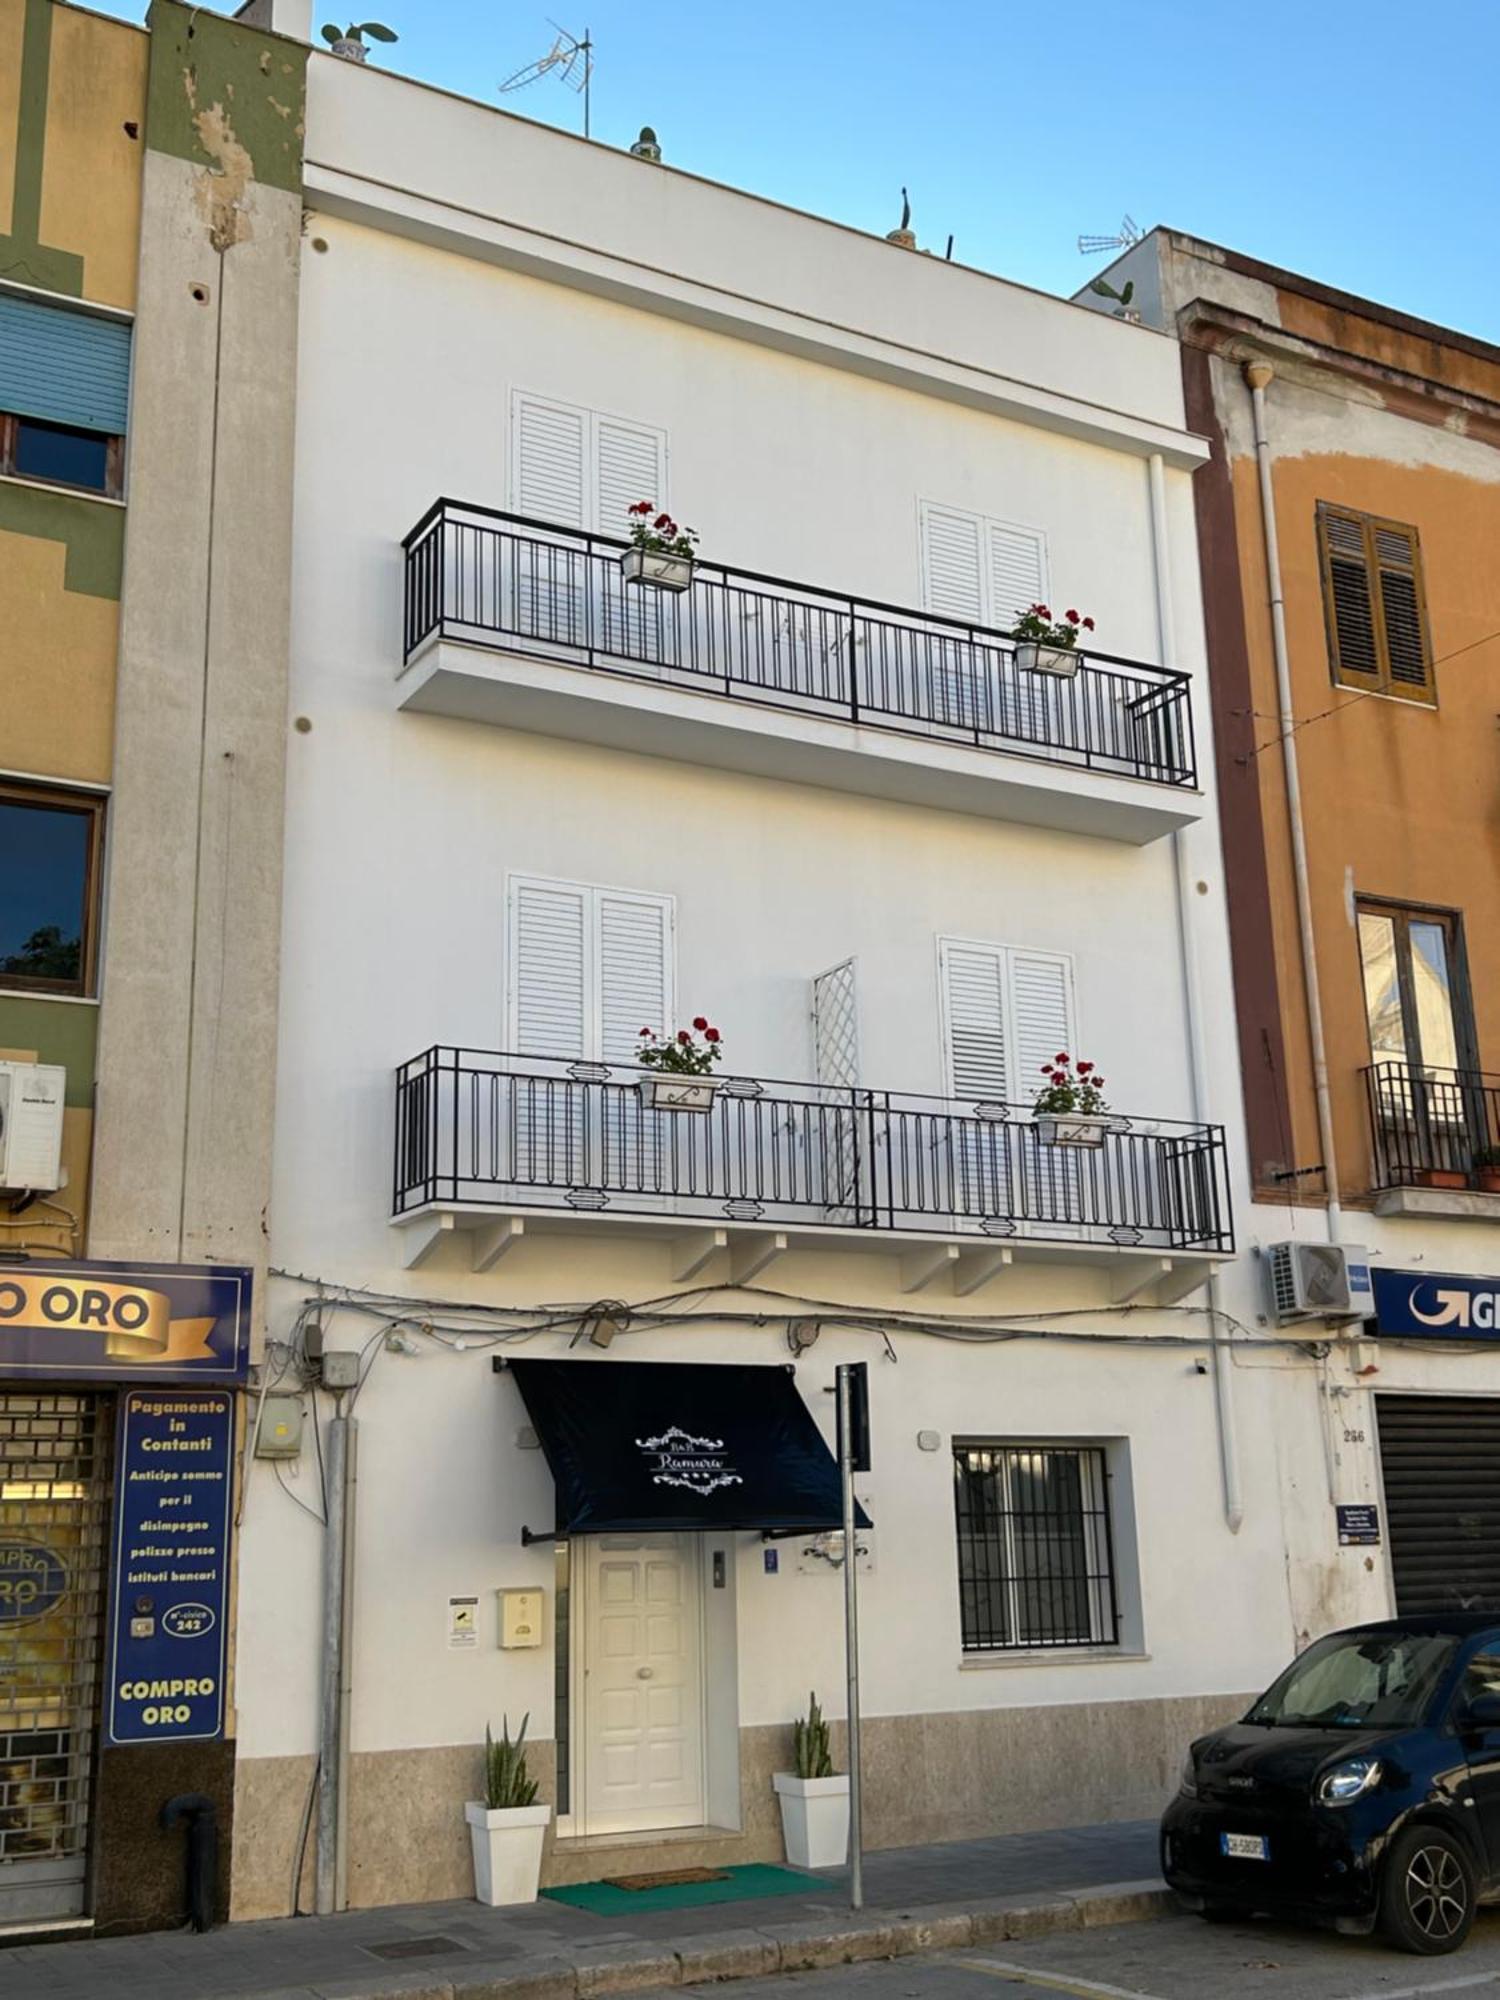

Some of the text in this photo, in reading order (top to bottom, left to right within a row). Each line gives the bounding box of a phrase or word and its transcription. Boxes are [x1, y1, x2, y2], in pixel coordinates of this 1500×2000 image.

[41, 1286, 149, 1329] ORO
[131, 1400, 225, 1416] Pagamento
[169, 1417, 186, 1432] in
[141, 1436, 212, 1451] Contanti
[130, 1470, 223, 1482] Anticipo somme
[159, 1494, 192, 1508] per il
[140, 1520, 209, 1533] disimpegno
[177, 1546, 216, 1558] presso
[128, 1569, 216, 1583] istituti bancari
[177, 1619, 201, 1631] 242
[119, 1677, 215, 1700] COMPRO
[142, 1705, 191, 1725] ORO
